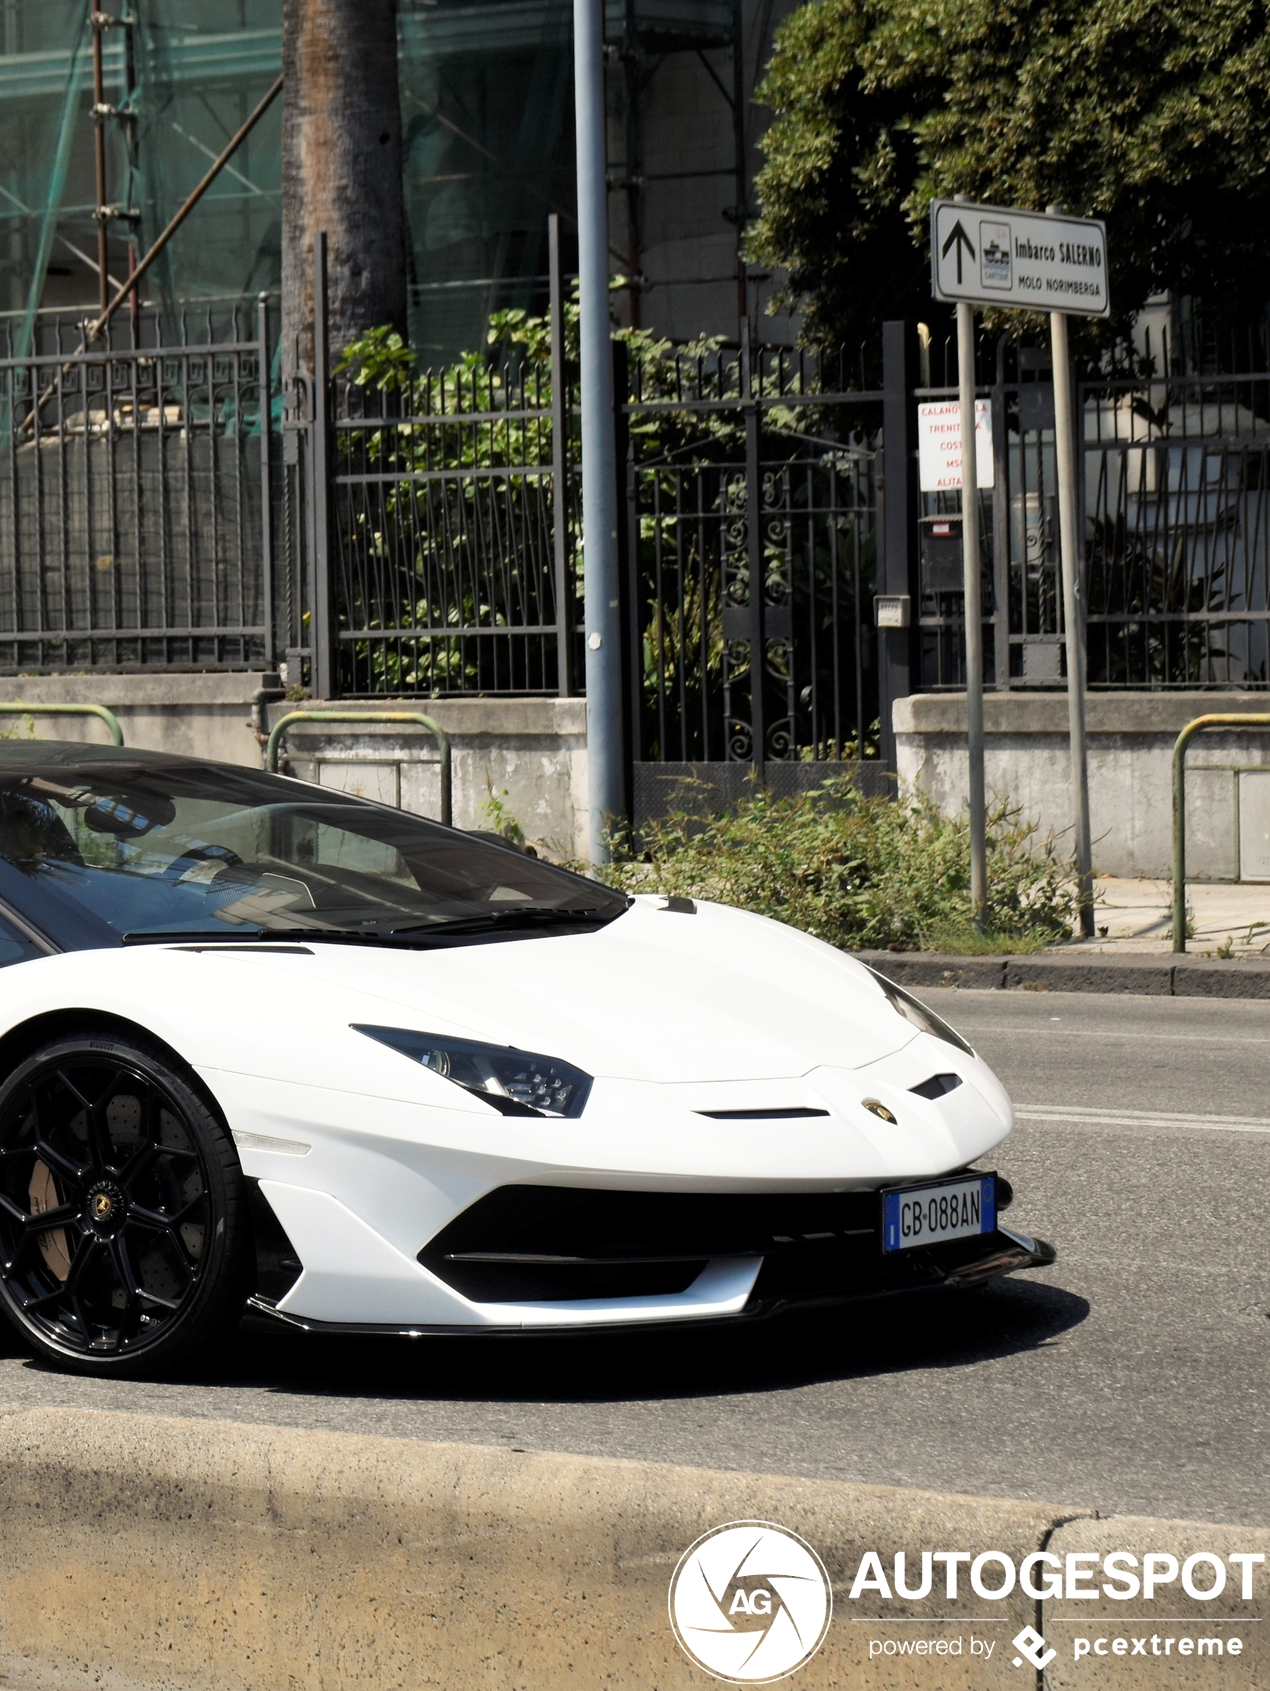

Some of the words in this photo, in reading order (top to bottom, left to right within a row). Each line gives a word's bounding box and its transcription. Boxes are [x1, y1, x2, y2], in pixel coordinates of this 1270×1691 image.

[1015, 236, 1055, 262] Imbarco
[1059, 242, 1102, 268] SALERNO
[1018, 275, 1042, 290] MOLO
[1046, 278, 1101, 297] NORIMBERGA
[940, 442, 962, 450] COST
[937, 477, 962, 486] ALITA
